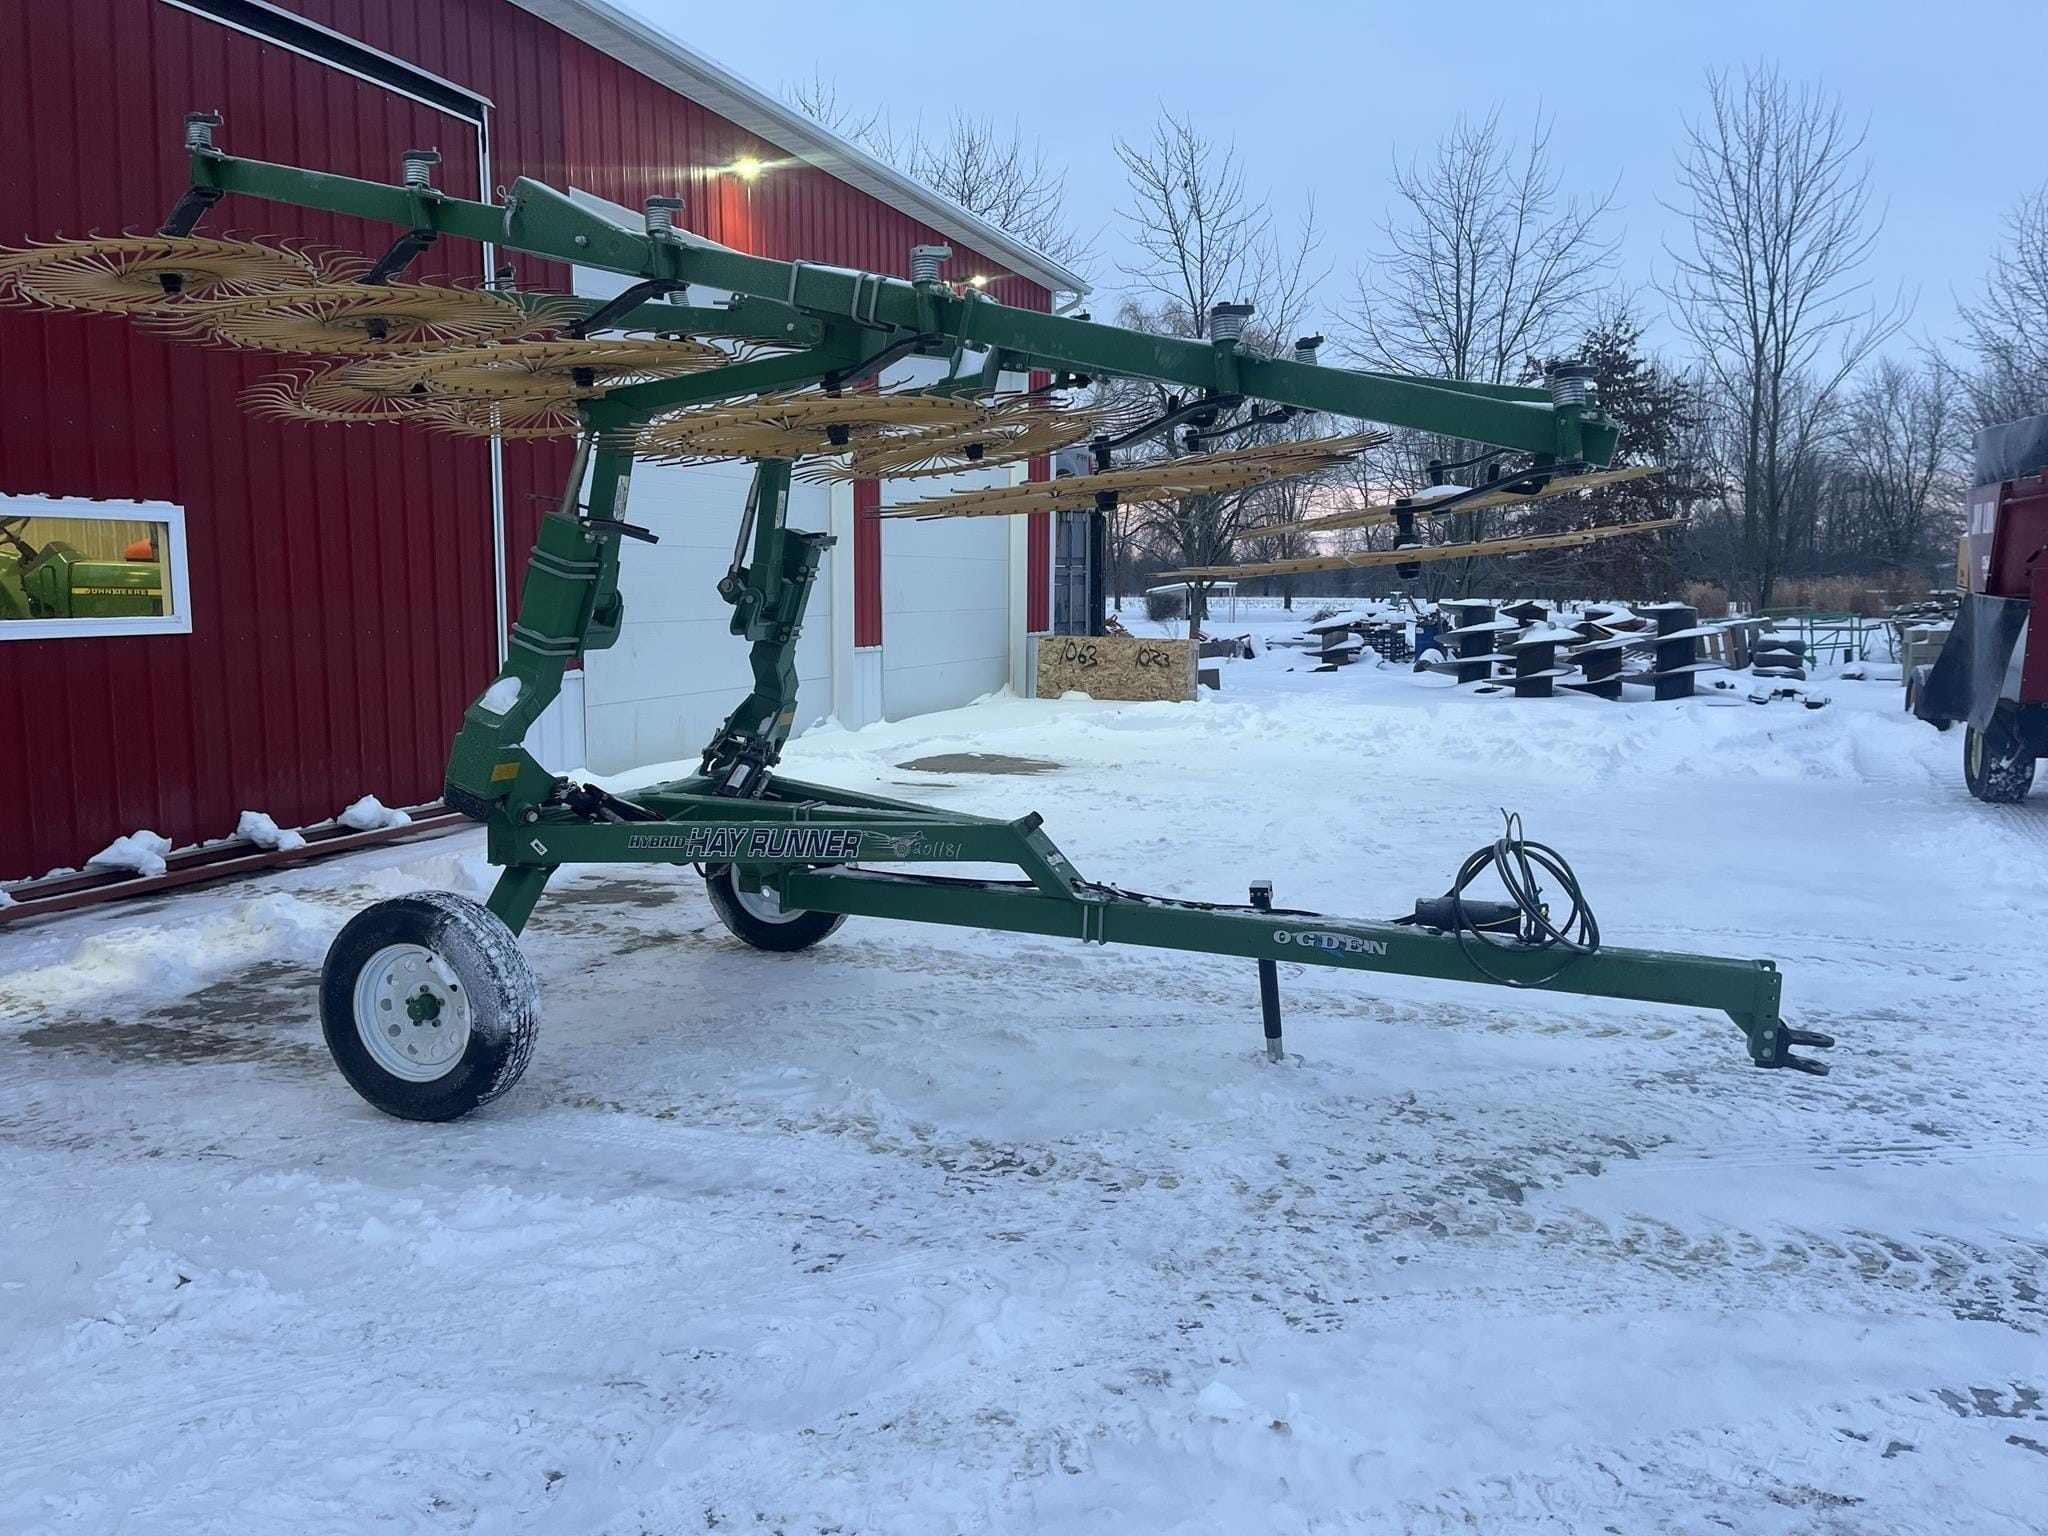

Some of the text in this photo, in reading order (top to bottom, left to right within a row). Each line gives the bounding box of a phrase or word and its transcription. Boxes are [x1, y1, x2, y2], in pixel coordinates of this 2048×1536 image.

[113, 588, 147, 596] DEERE
[1058, 638, 1098, 668] 1063
[628, 828, 863, 858] HYBRID HAY RUNNER
[1273, 930, 1389, 956] OGDEN
